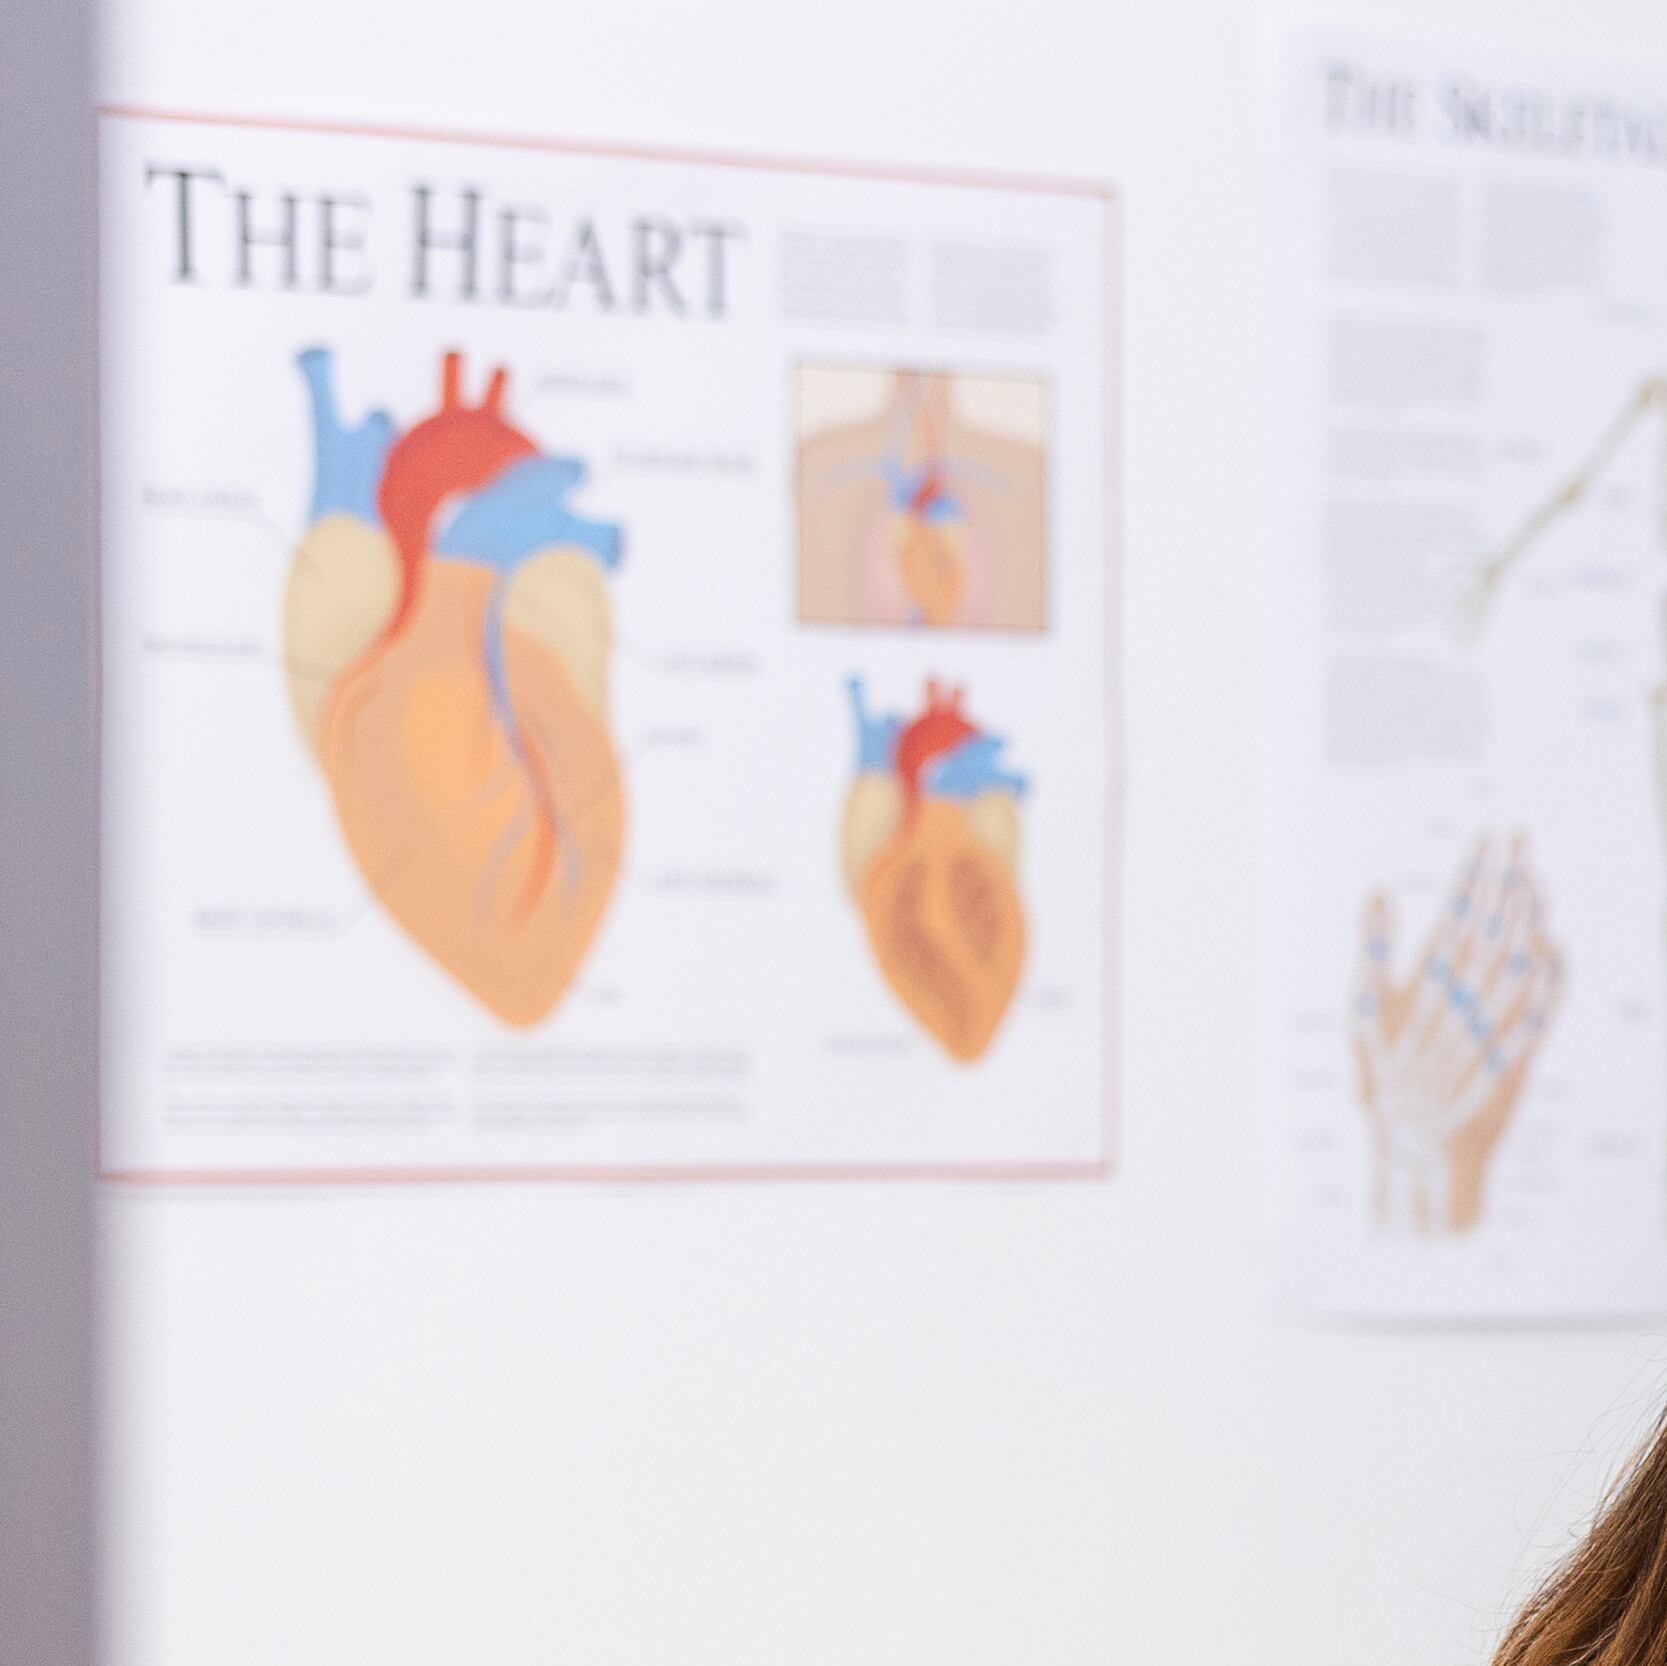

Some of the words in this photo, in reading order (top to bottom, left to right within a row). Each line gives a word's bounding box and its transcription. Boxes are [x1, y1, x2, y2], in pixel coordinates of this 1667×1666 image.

[1322, 58, 1416, 134] THE
[145, 163, 376, 296] THE
[408, 183, 751, 321] HEART
